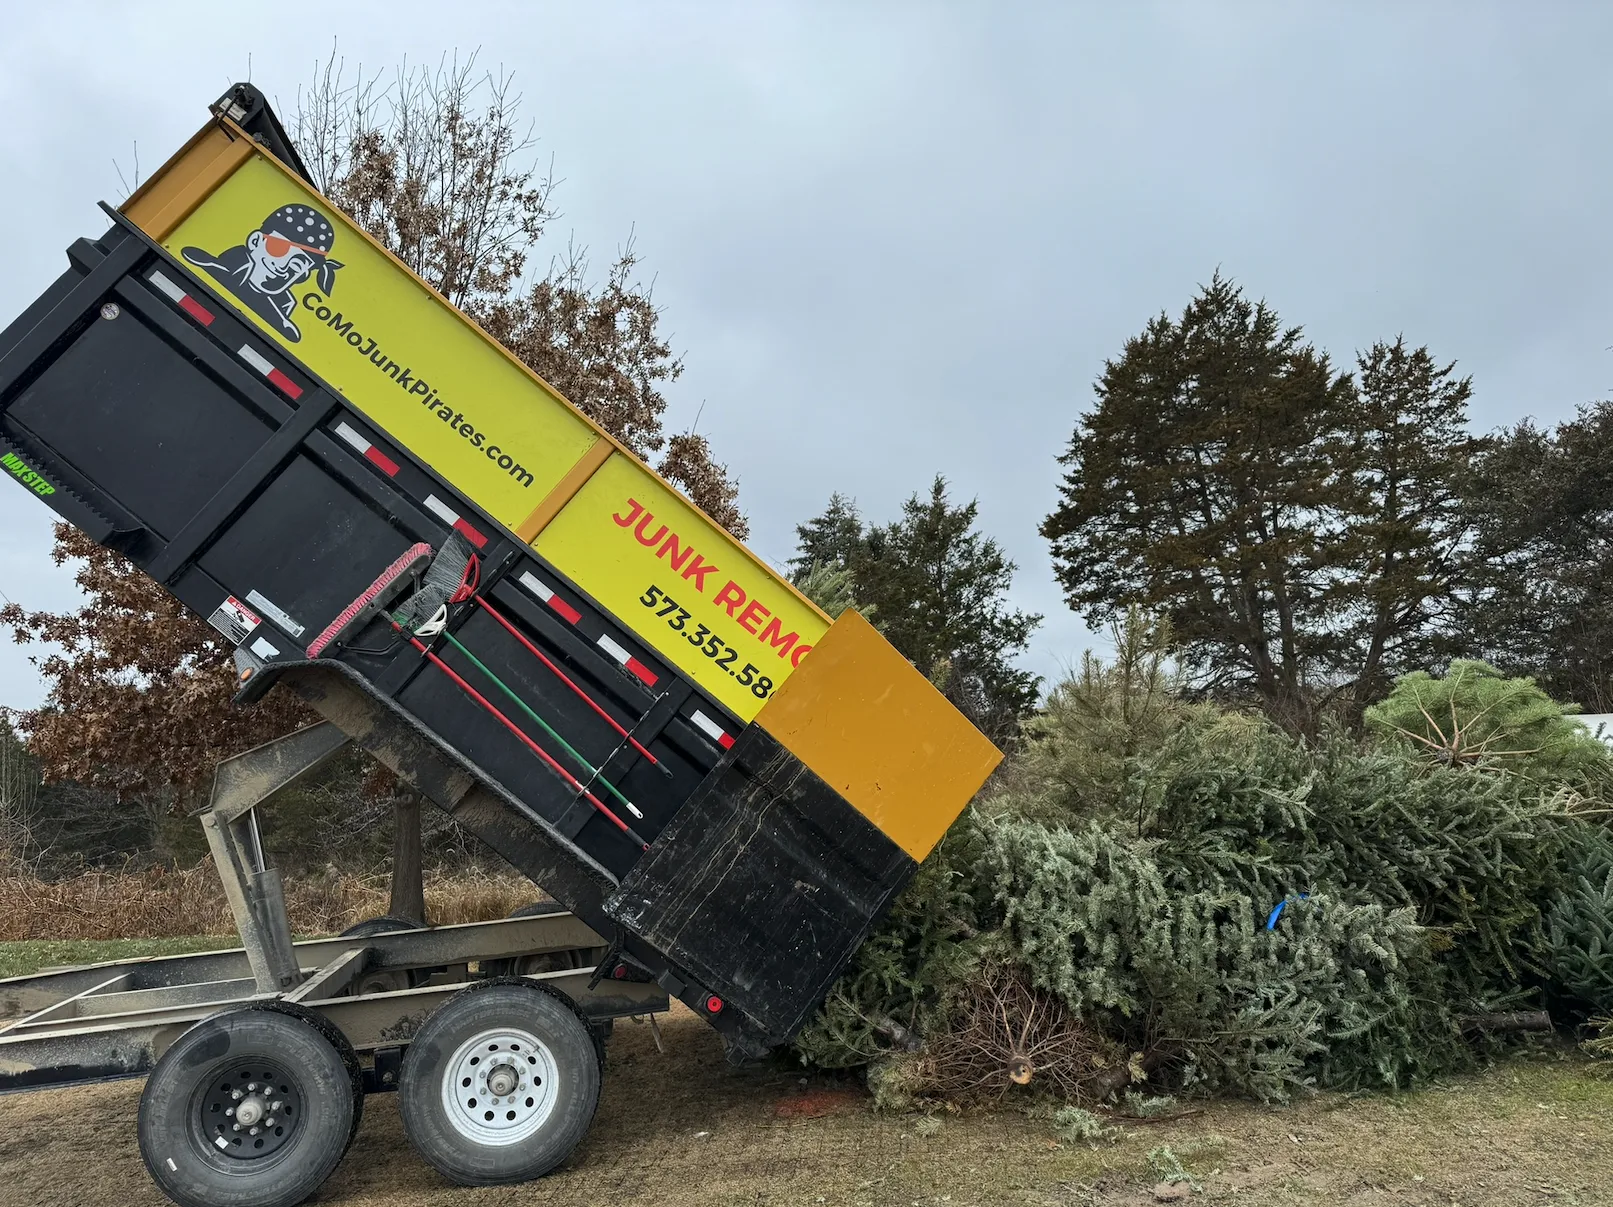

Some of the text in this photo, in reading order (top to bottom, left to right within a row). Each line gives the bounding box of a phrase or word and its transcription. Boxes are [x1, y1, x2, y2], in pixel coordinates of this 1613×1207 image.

[302, 292, 534, 488] CoMoJunkPirates.com
[612, 497, 720, 593] JUNK
[236, 603, 256, 621] DANGER
[639, 584, 776, 700] 573.352.58
